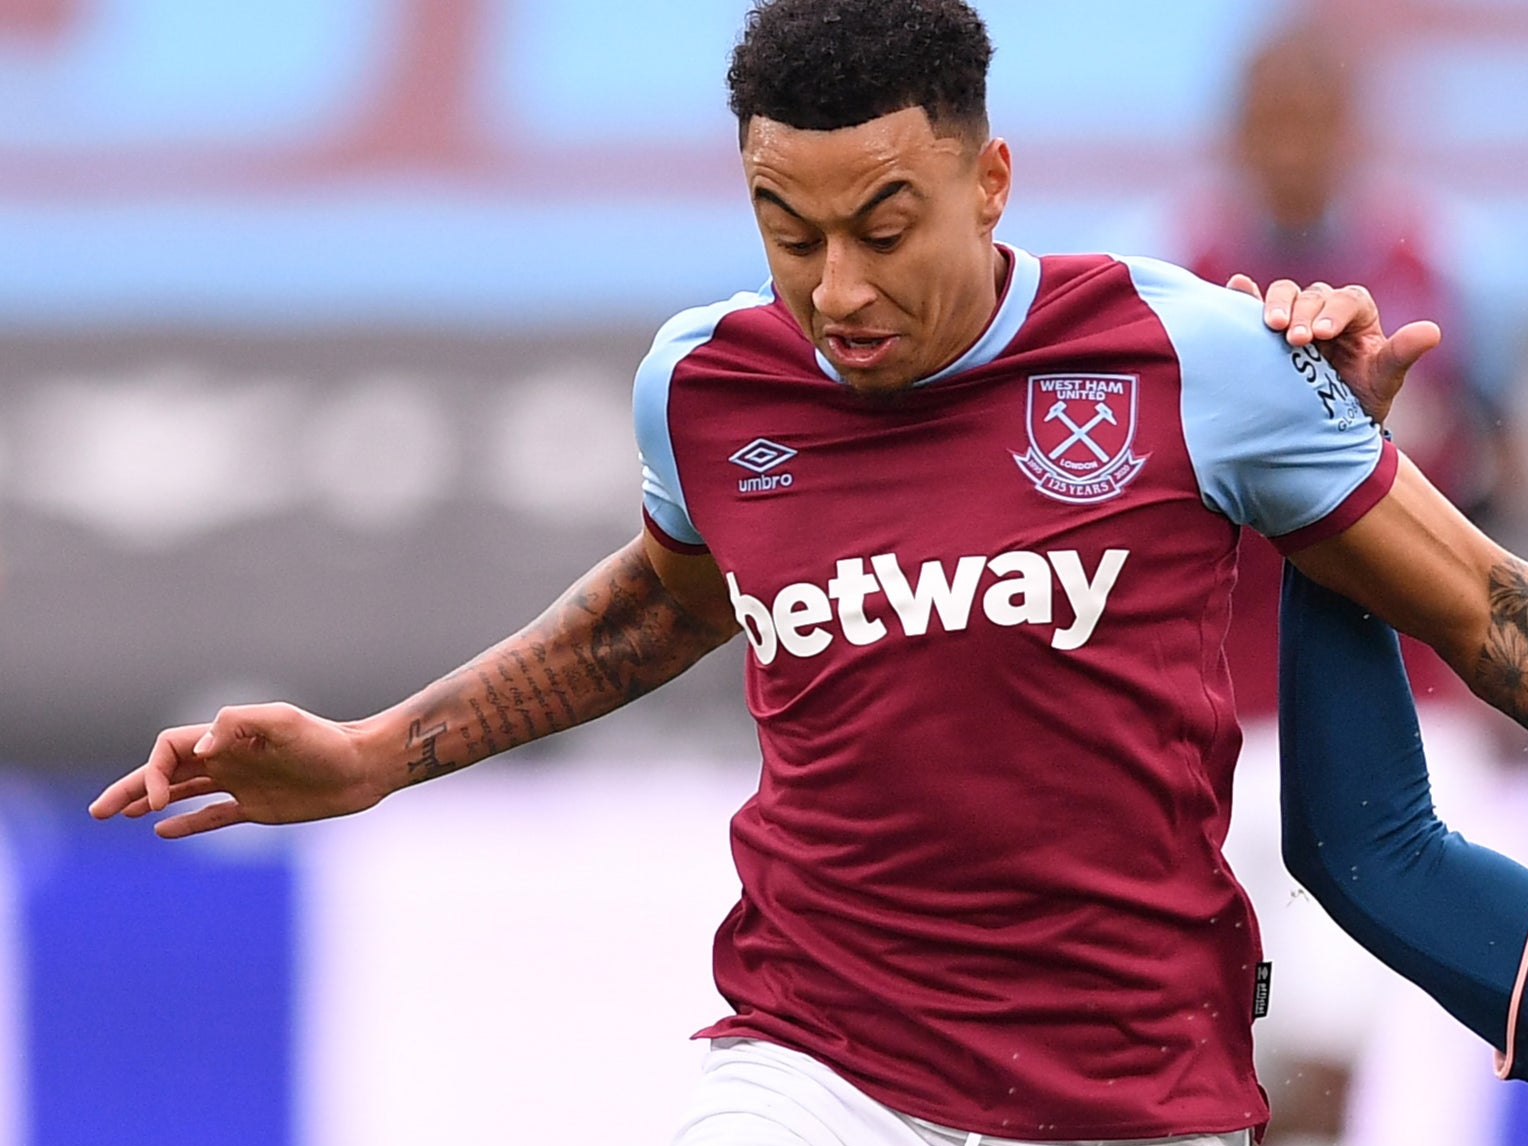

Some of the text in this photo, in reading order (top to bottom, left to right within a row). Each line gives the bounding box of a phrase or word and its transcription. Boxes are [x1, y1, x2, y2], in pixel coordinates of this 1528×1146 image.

[1040, 379, 1124, 395] WEST HAM
[1056, 389, 1106, 401] UNITED
[1059, 458, 1099, 471] LONDON
[738, 472, 794, 493] umbro
[1047, 478, 1110, 496] 125 YEARS
[725, 548, 1131, 666] betway
